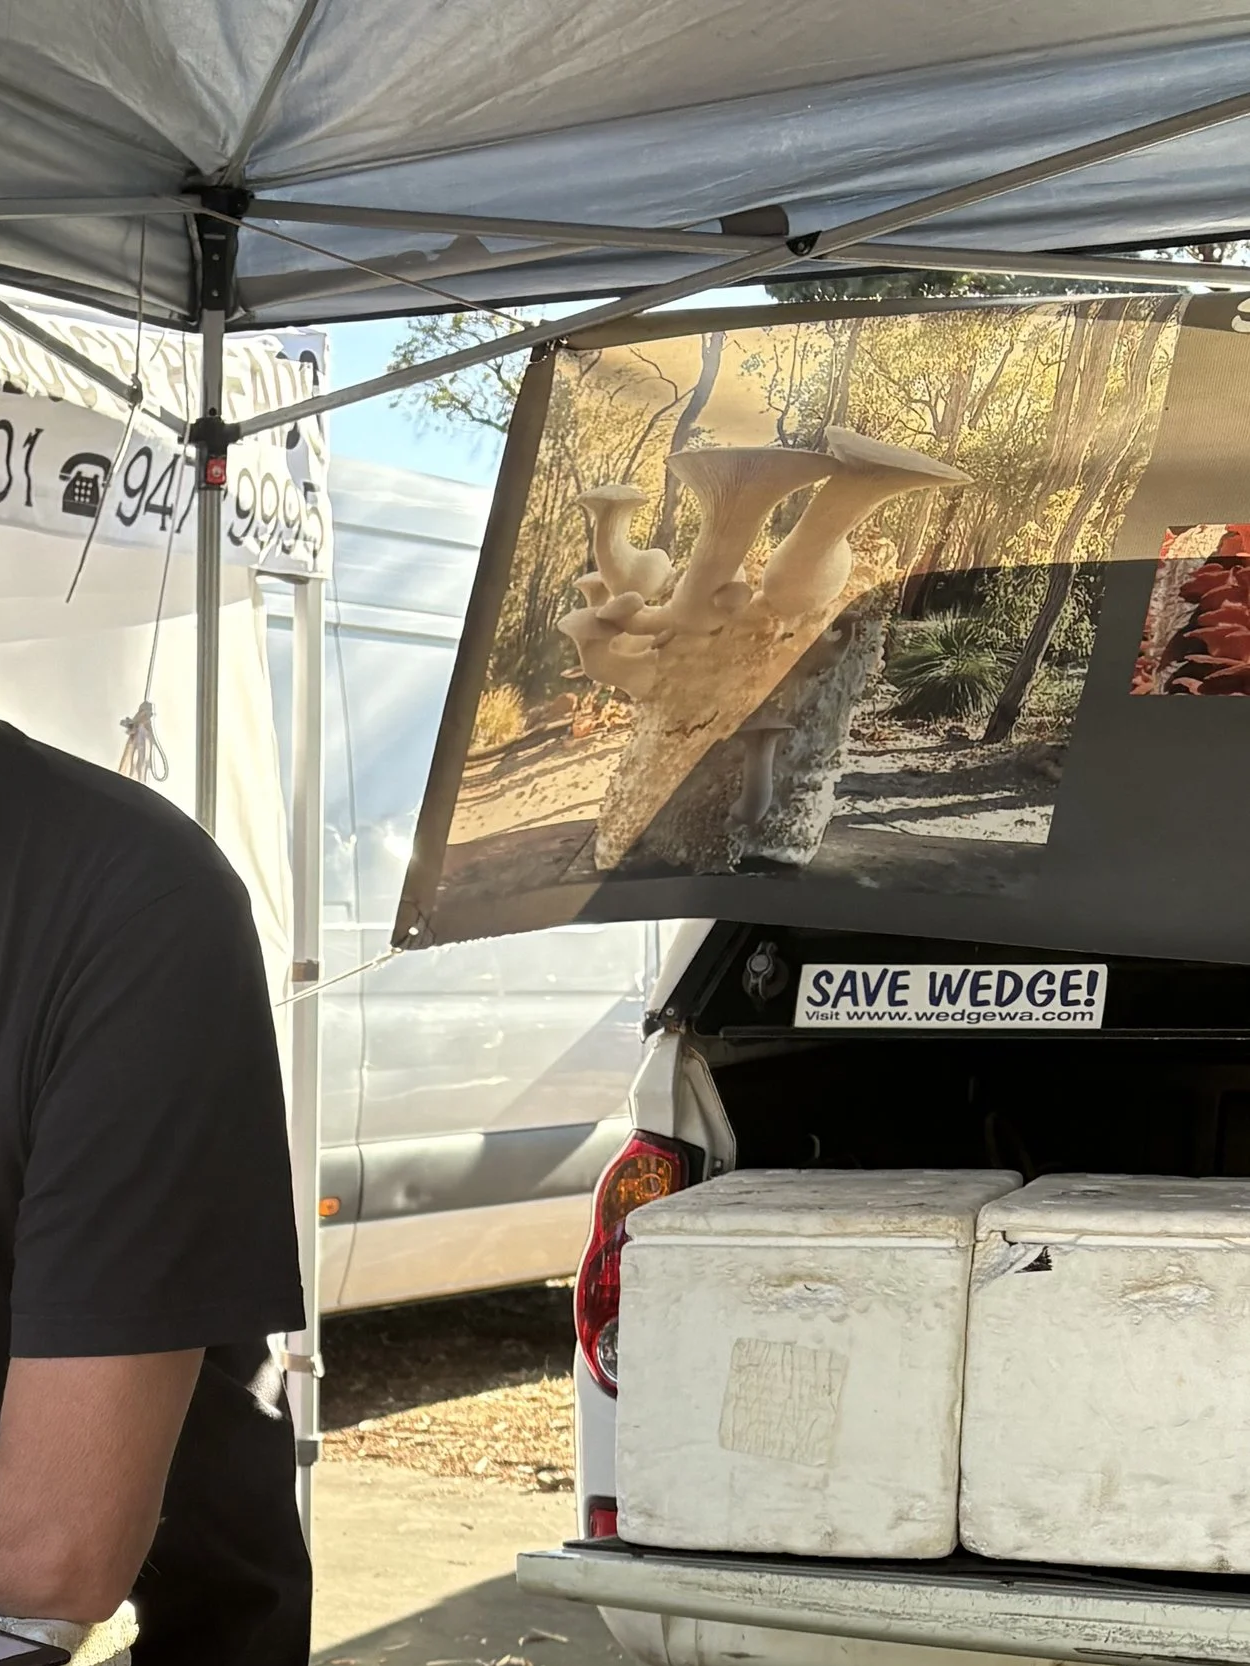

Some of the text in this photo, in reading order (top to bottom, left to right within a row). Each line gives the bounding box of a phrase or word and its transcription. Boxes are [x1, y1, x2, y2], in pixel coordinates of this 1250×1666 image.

[806, 968, 1100, 1007] SAVE WEDGE!
[805, 1009, 1094, 1025] Visit www.wedgewa.com
